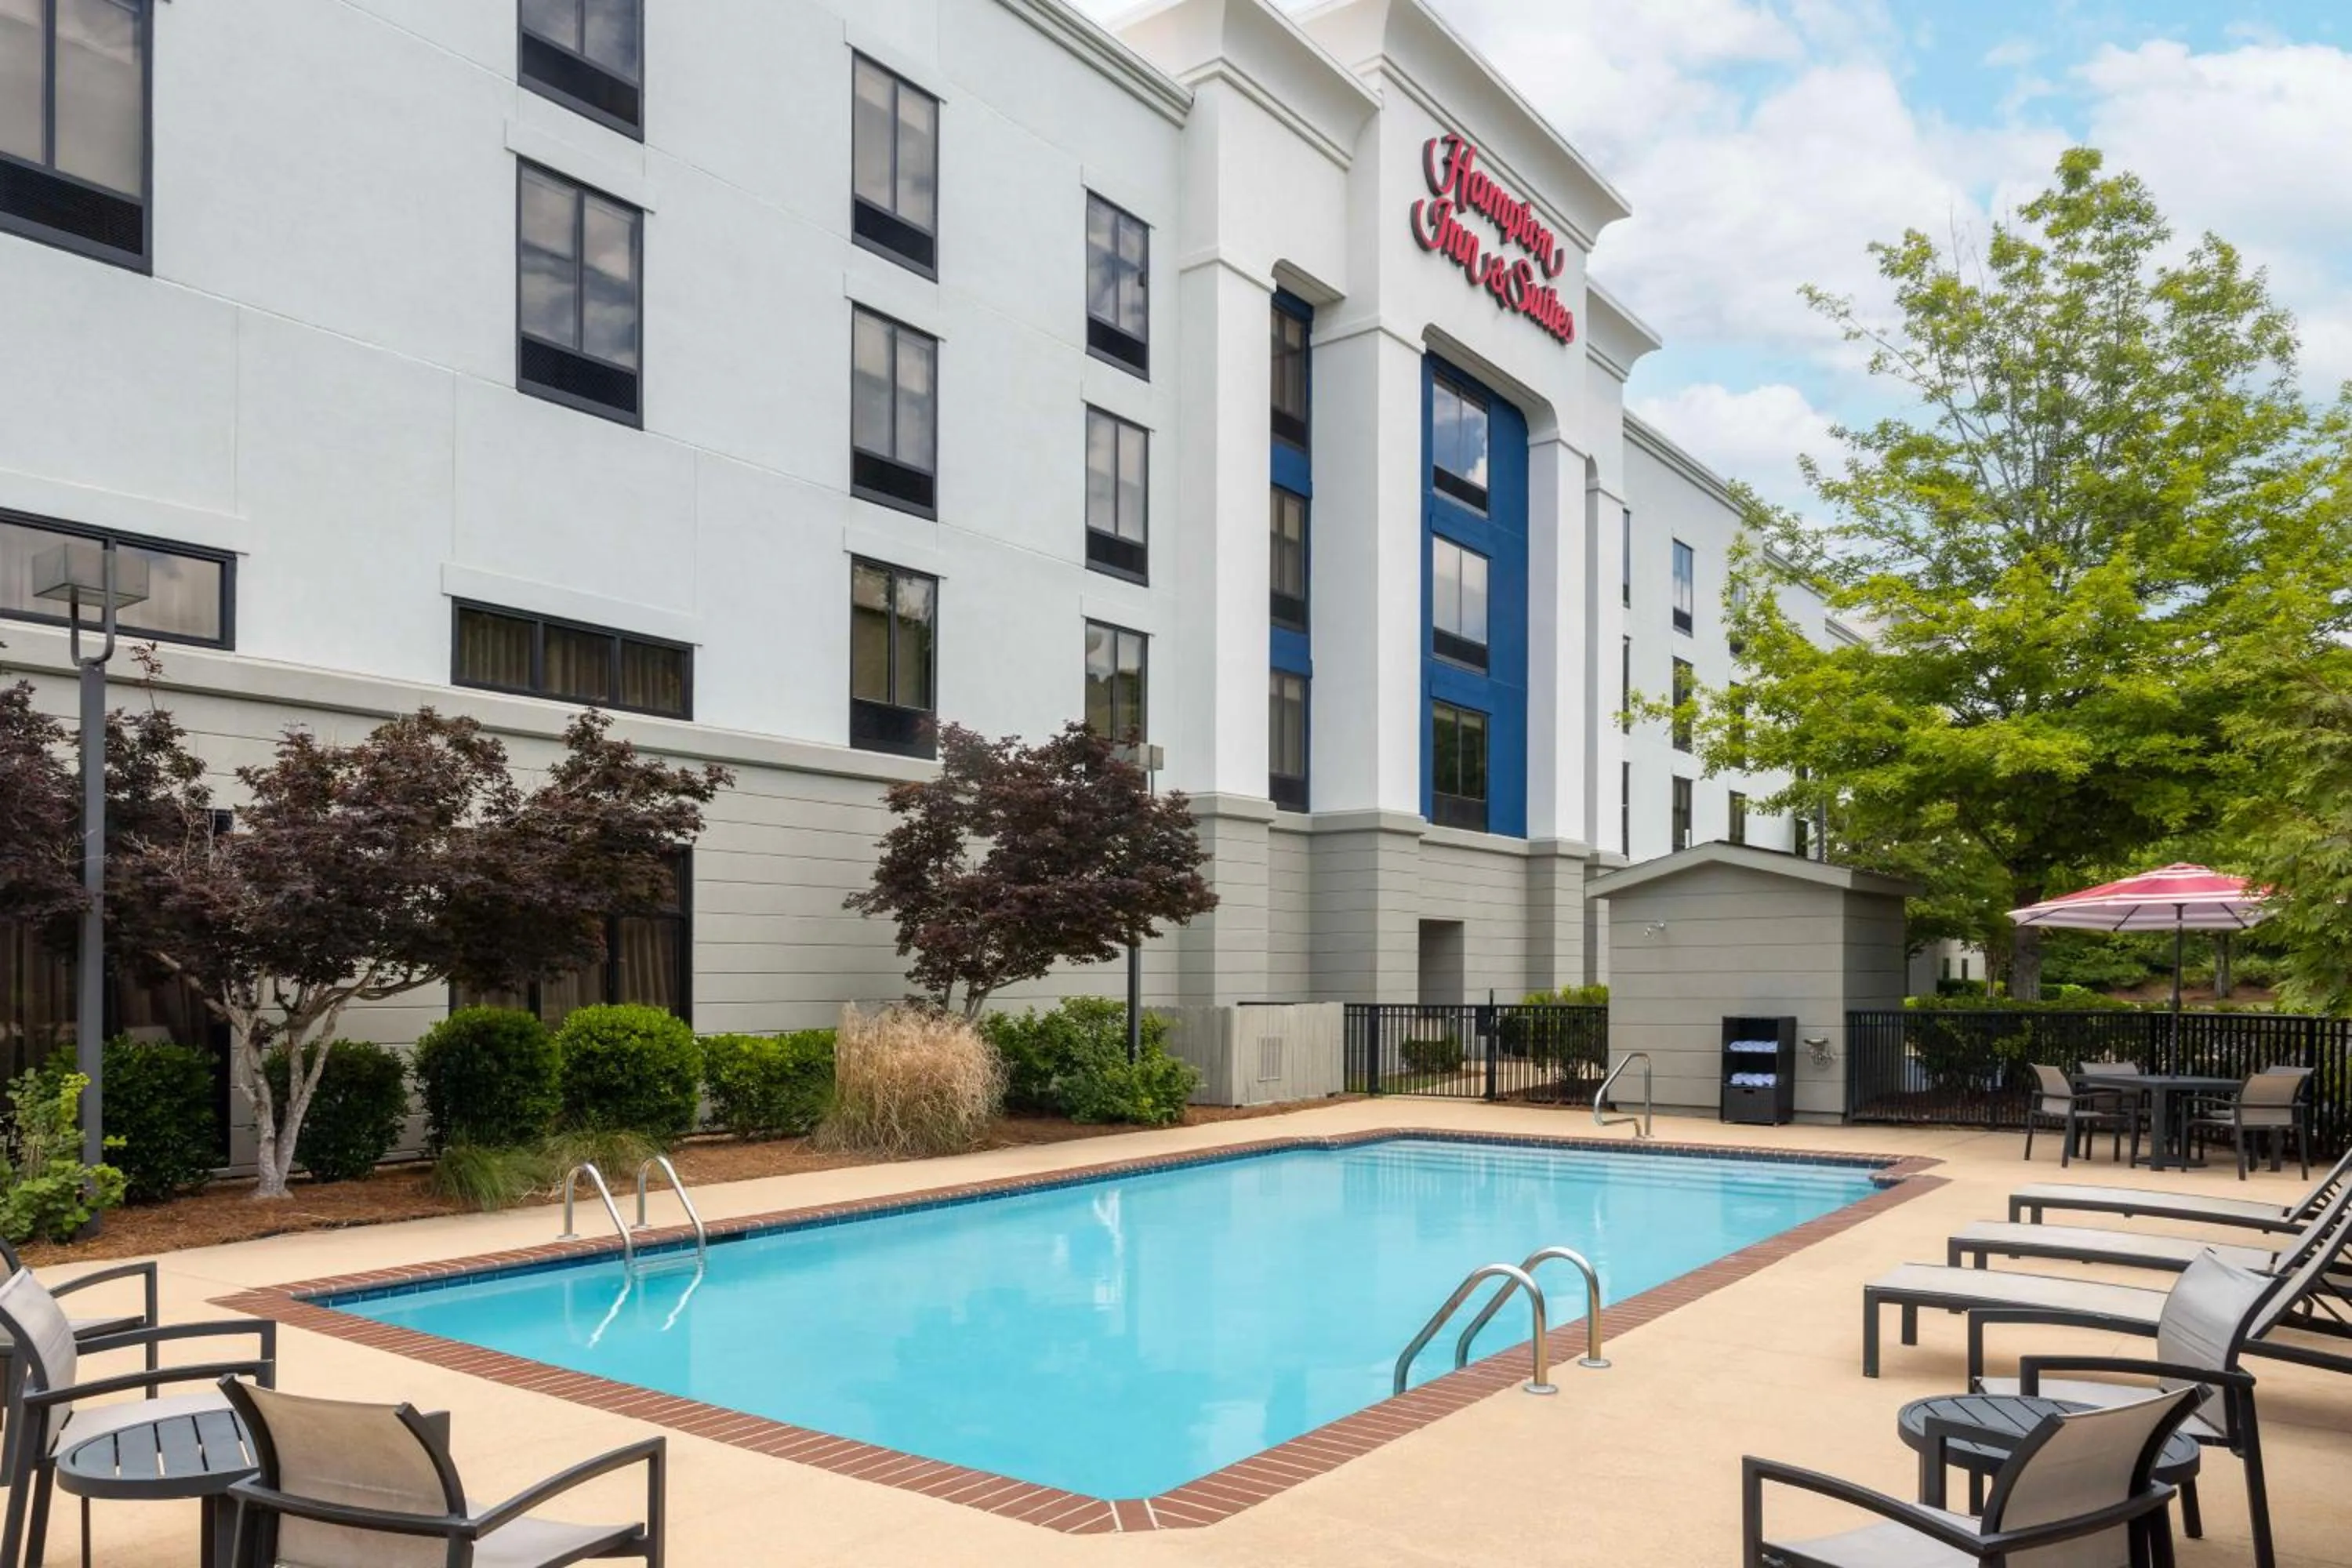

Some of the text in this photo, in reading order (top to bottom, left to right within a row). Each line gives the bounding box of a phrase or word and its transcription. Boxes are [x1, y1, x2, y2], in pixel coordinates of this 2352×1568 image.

[1410, 198, 1575, 345] Inn & Suites
[1422, 132, 1565, 278] Hampton
